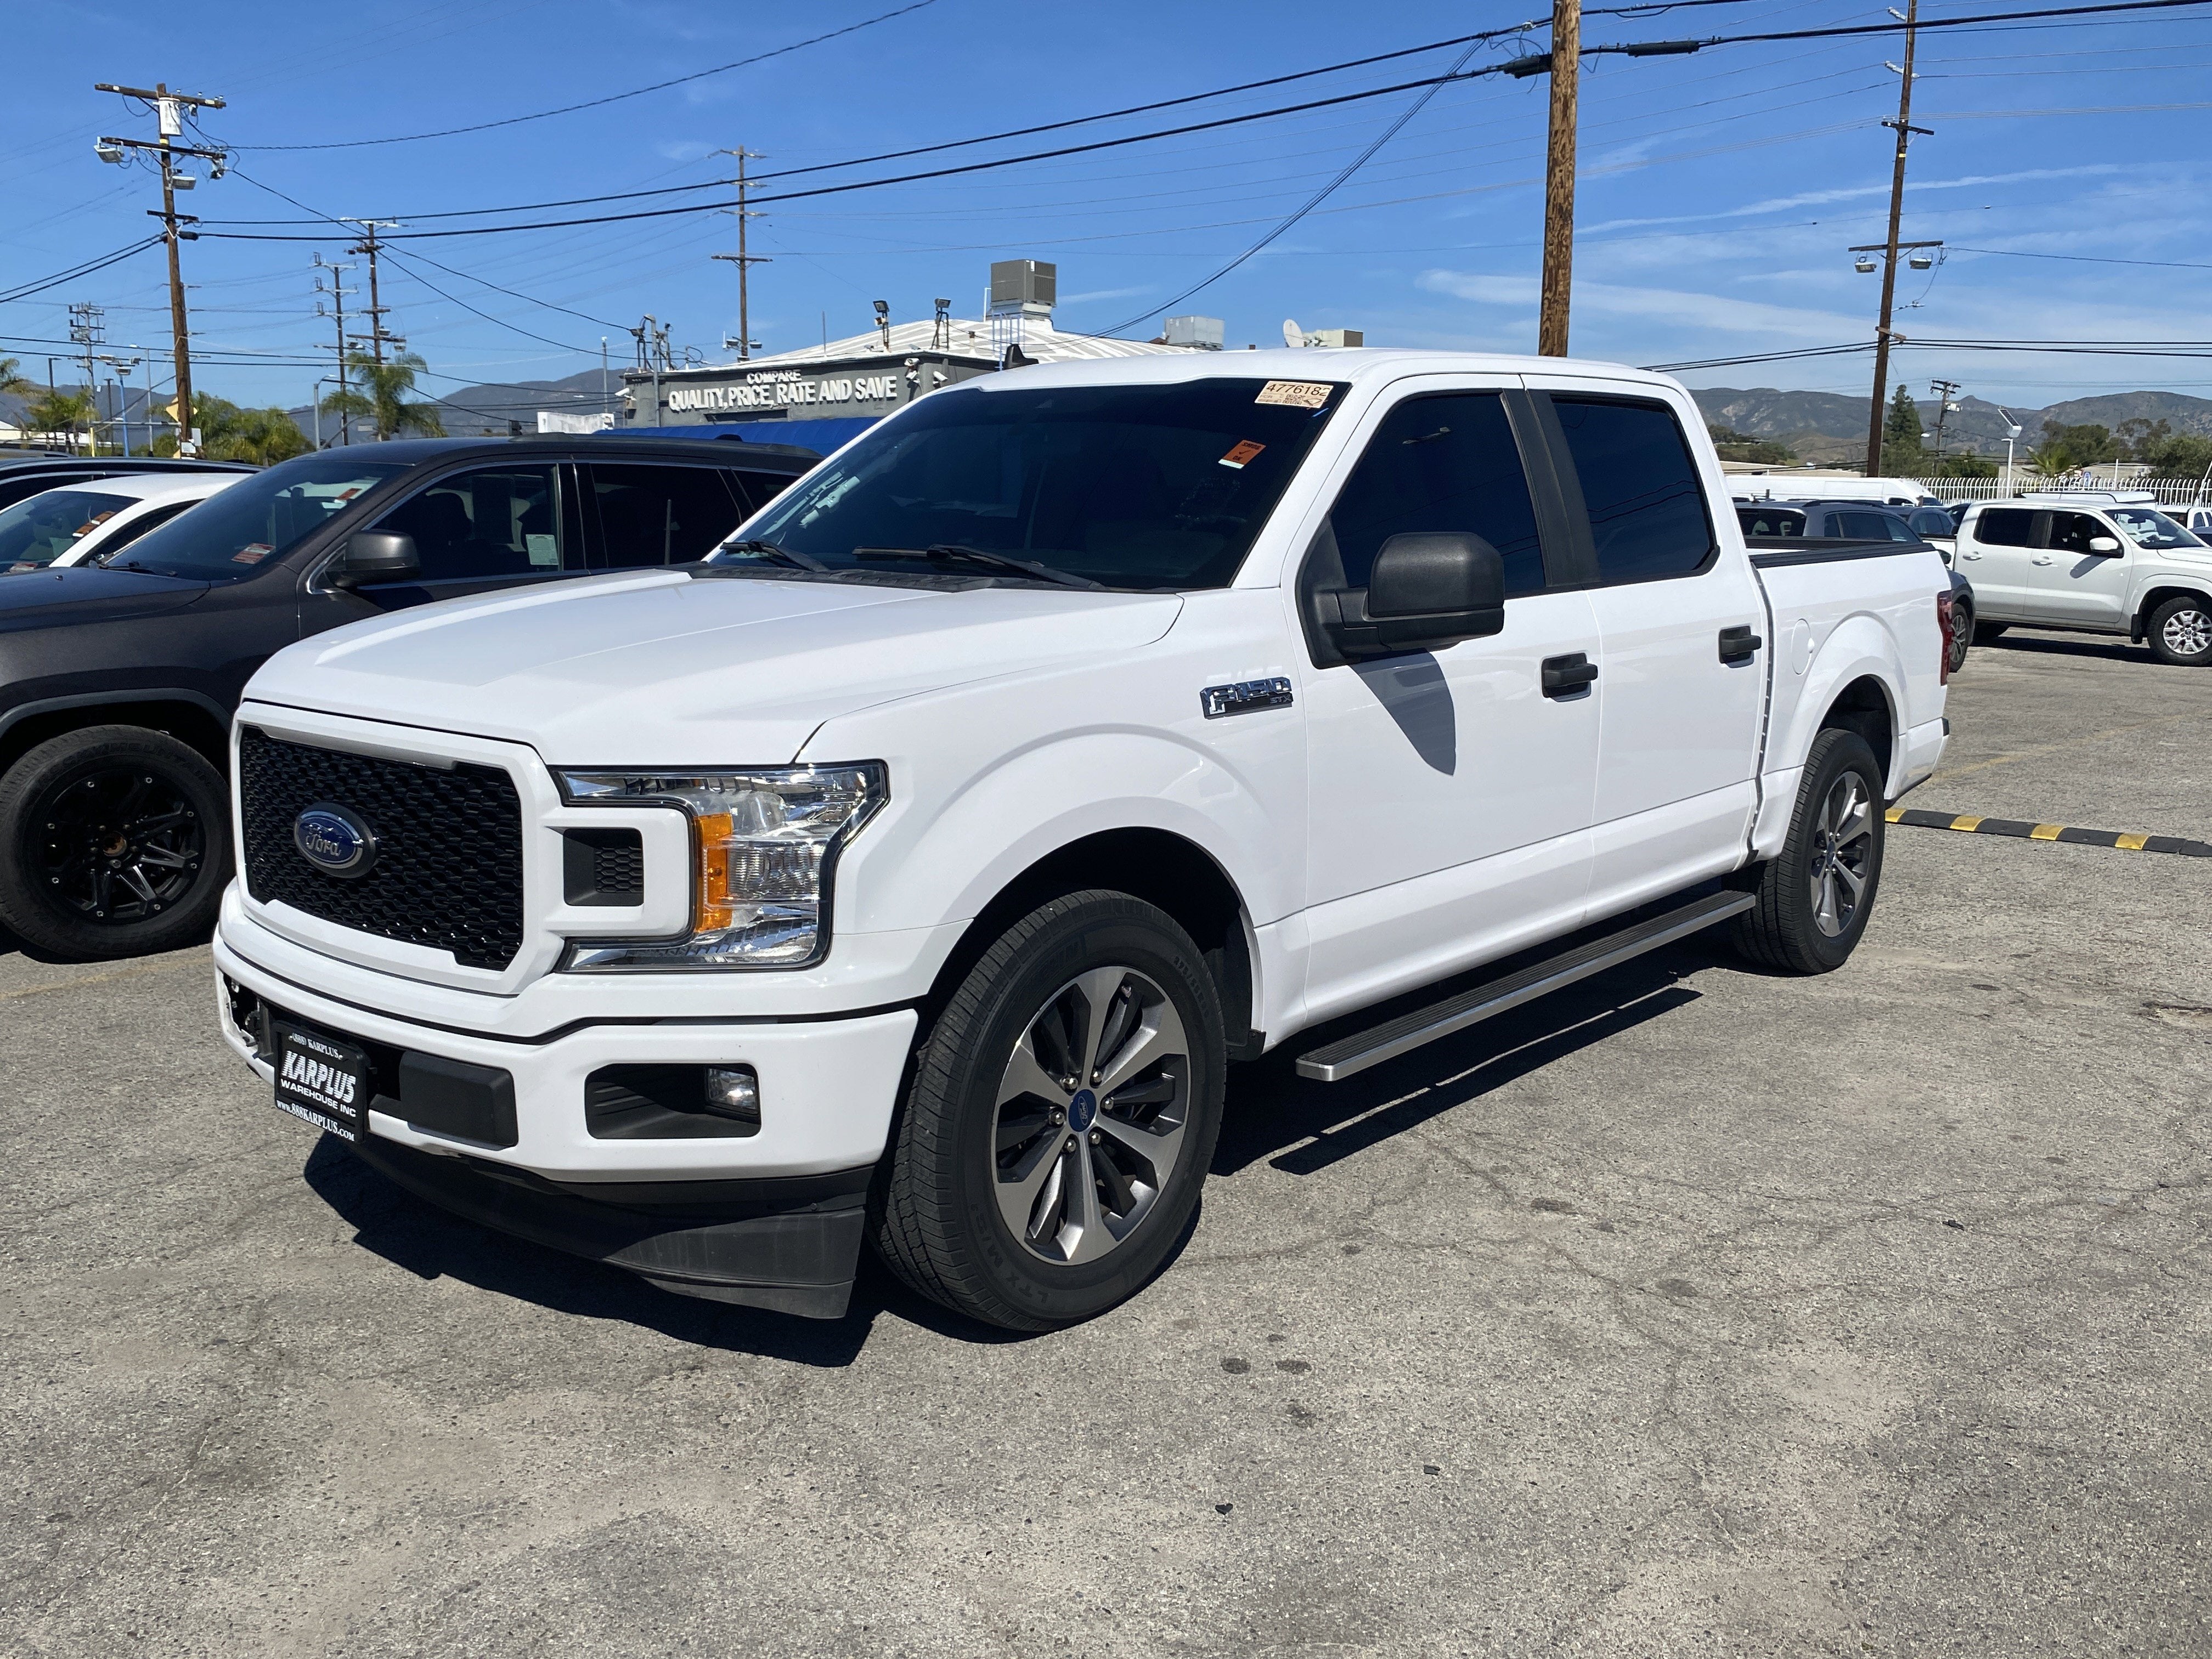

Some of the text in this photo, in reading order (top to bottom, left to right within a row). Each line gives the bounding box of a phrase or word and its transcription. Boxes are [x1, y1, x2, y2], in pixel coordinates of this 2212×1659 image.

[747, 370, 802, 384] COMPARE
[1266, 383, 1331, 397] 4776182
[668, 376, 898, 411] QUALITY, PRICE, RATE AND SAVE
[1270, 696, 1292, 704] STX
[304, 822, 344, 857] Ford
[307, 1039, 340, 1058] KARPLUS
[281, 1050, 357, 1104] KARPLUS
[280, 1078, 356, 1118] WAREHOUSE INC
